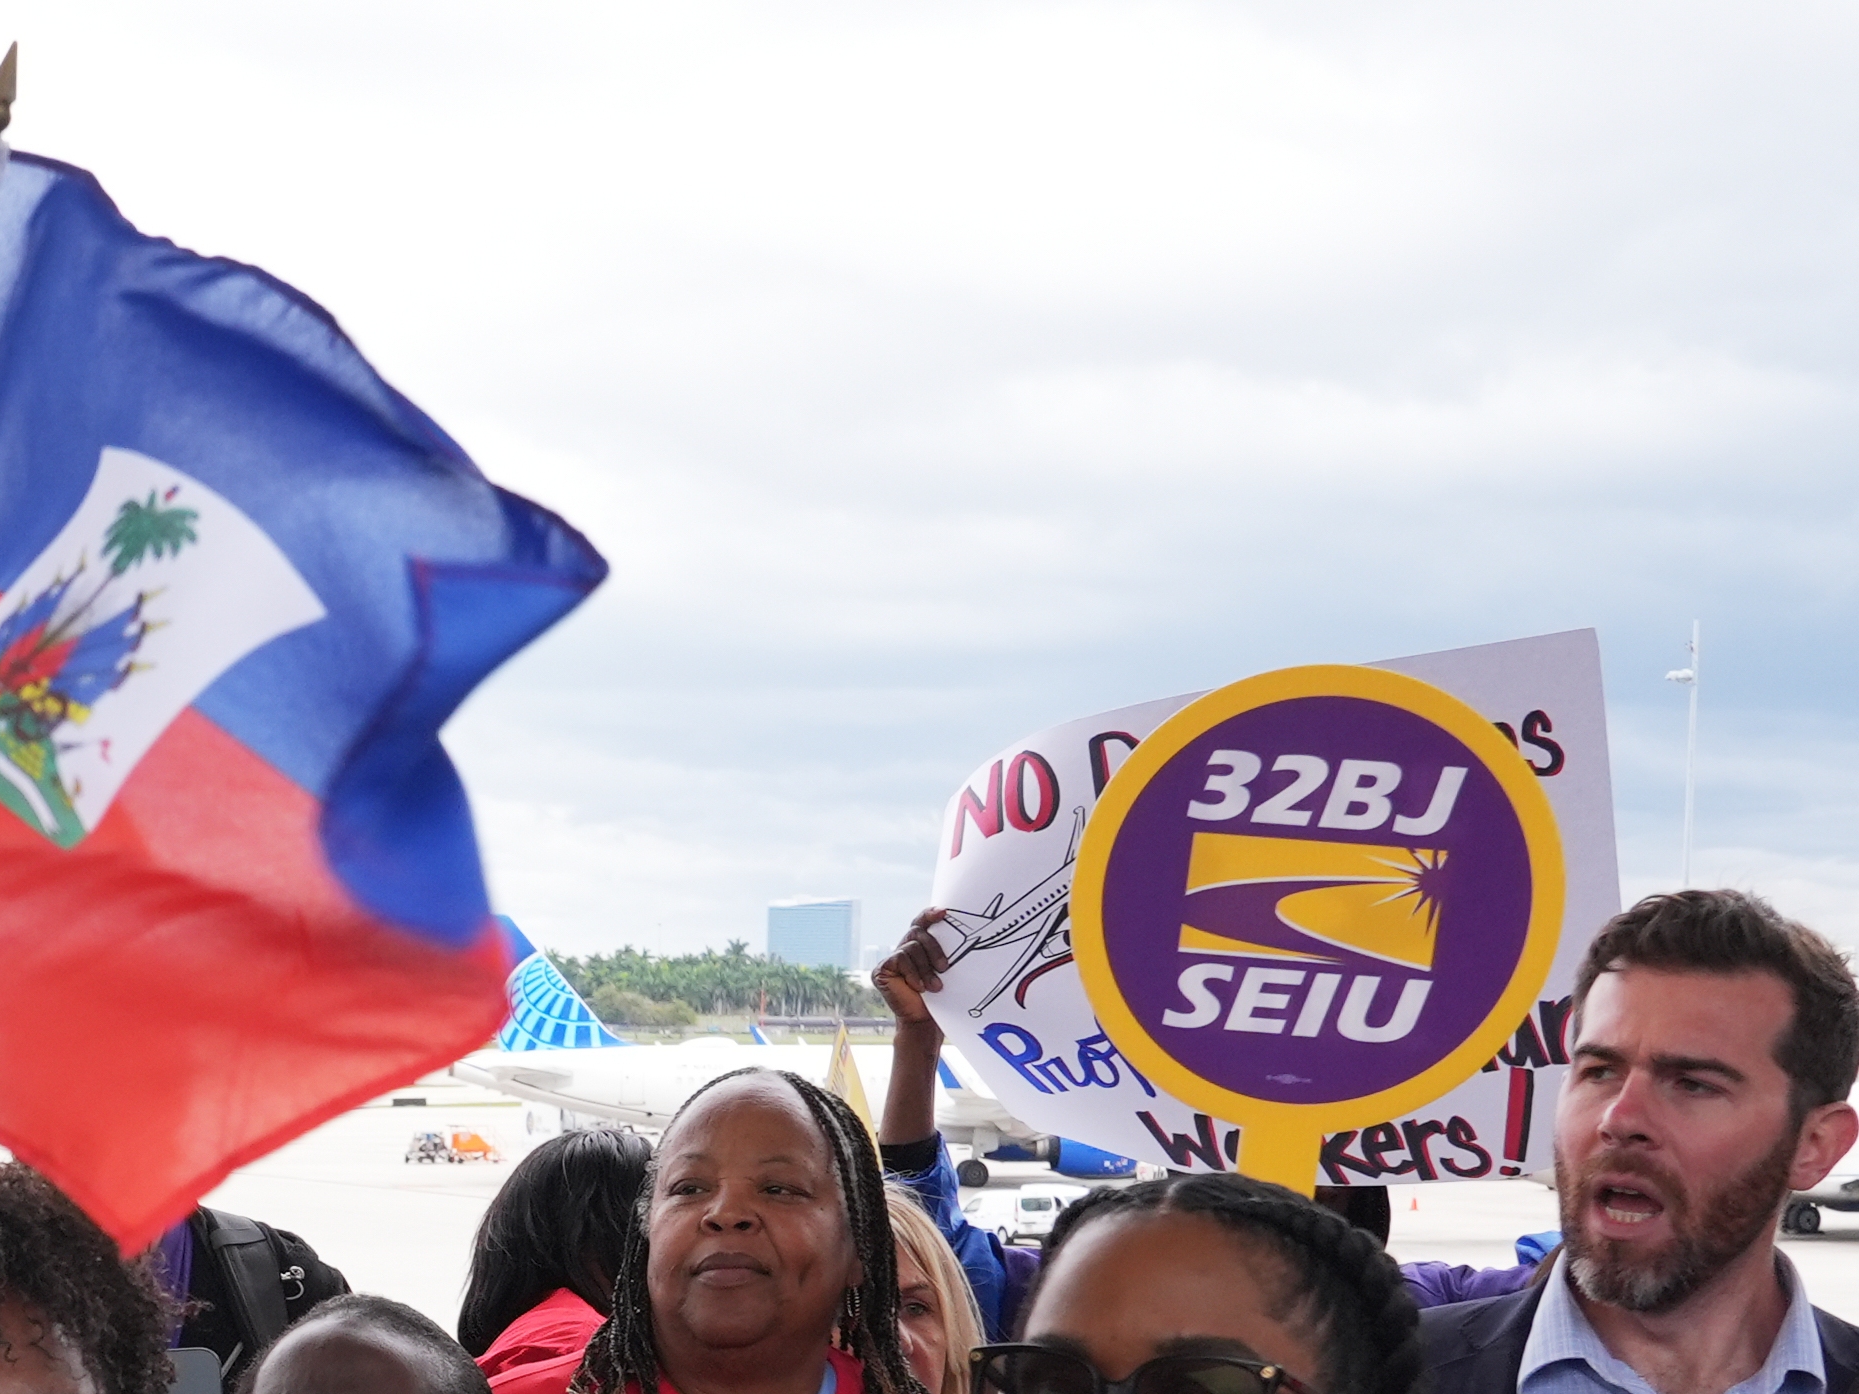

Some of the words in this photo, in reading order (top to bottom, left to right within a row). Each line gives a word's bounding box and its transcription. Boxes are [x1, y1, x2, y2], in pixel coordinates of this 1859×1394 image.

[950, 749, 1060, 859] NO
[1186, 749, 1468, 837] 32BJ
[1161, 962, 1434, 1043] SEIU
